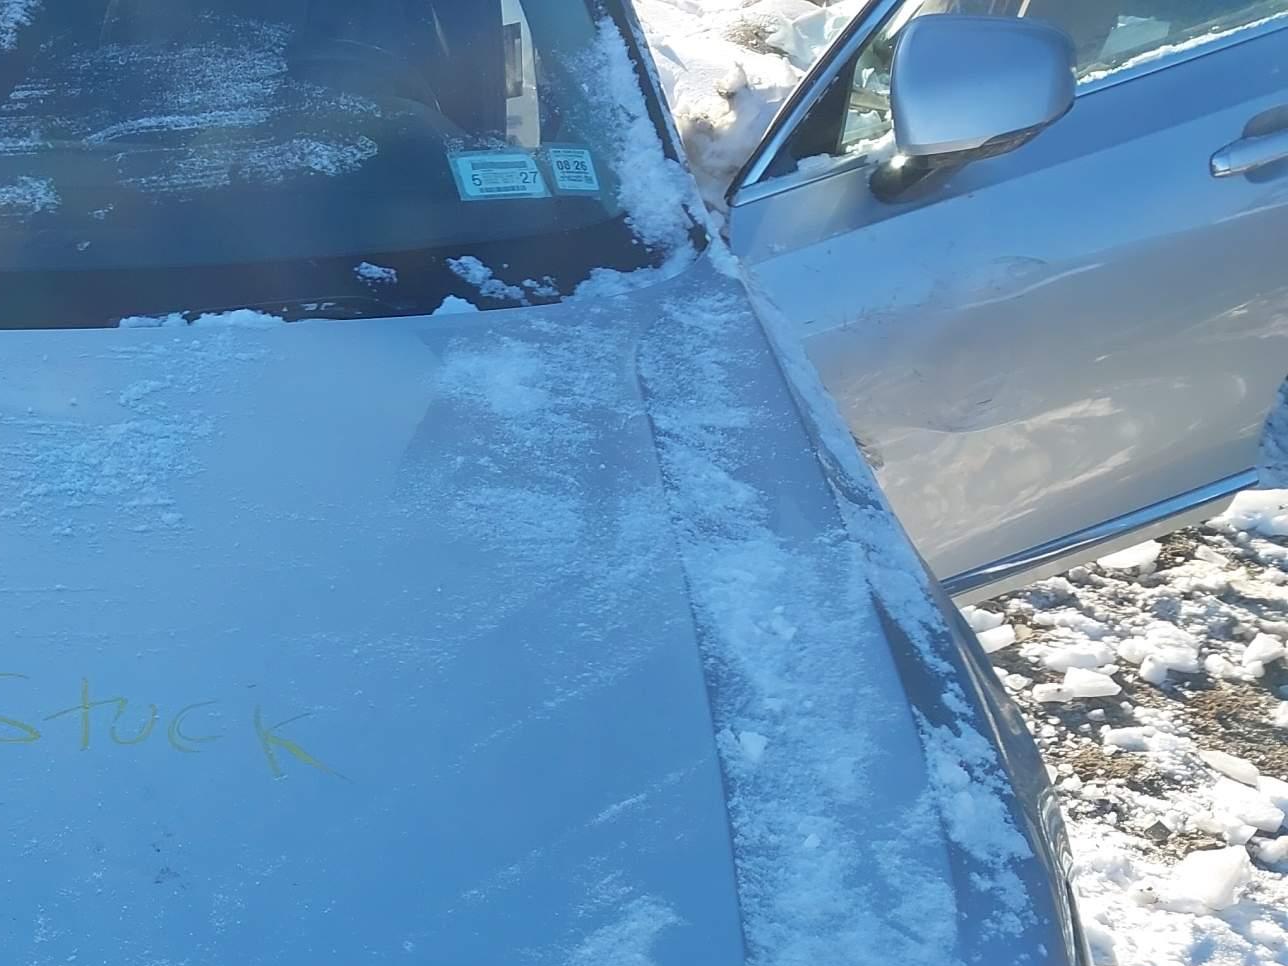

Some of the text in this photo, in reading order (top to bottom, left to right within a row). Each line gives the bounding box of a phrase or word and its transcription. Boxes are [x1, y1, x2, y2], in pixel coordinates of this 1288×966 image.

[556, 160, 588, 171] 08 26
[471, 171, 539, 187] 5 27
